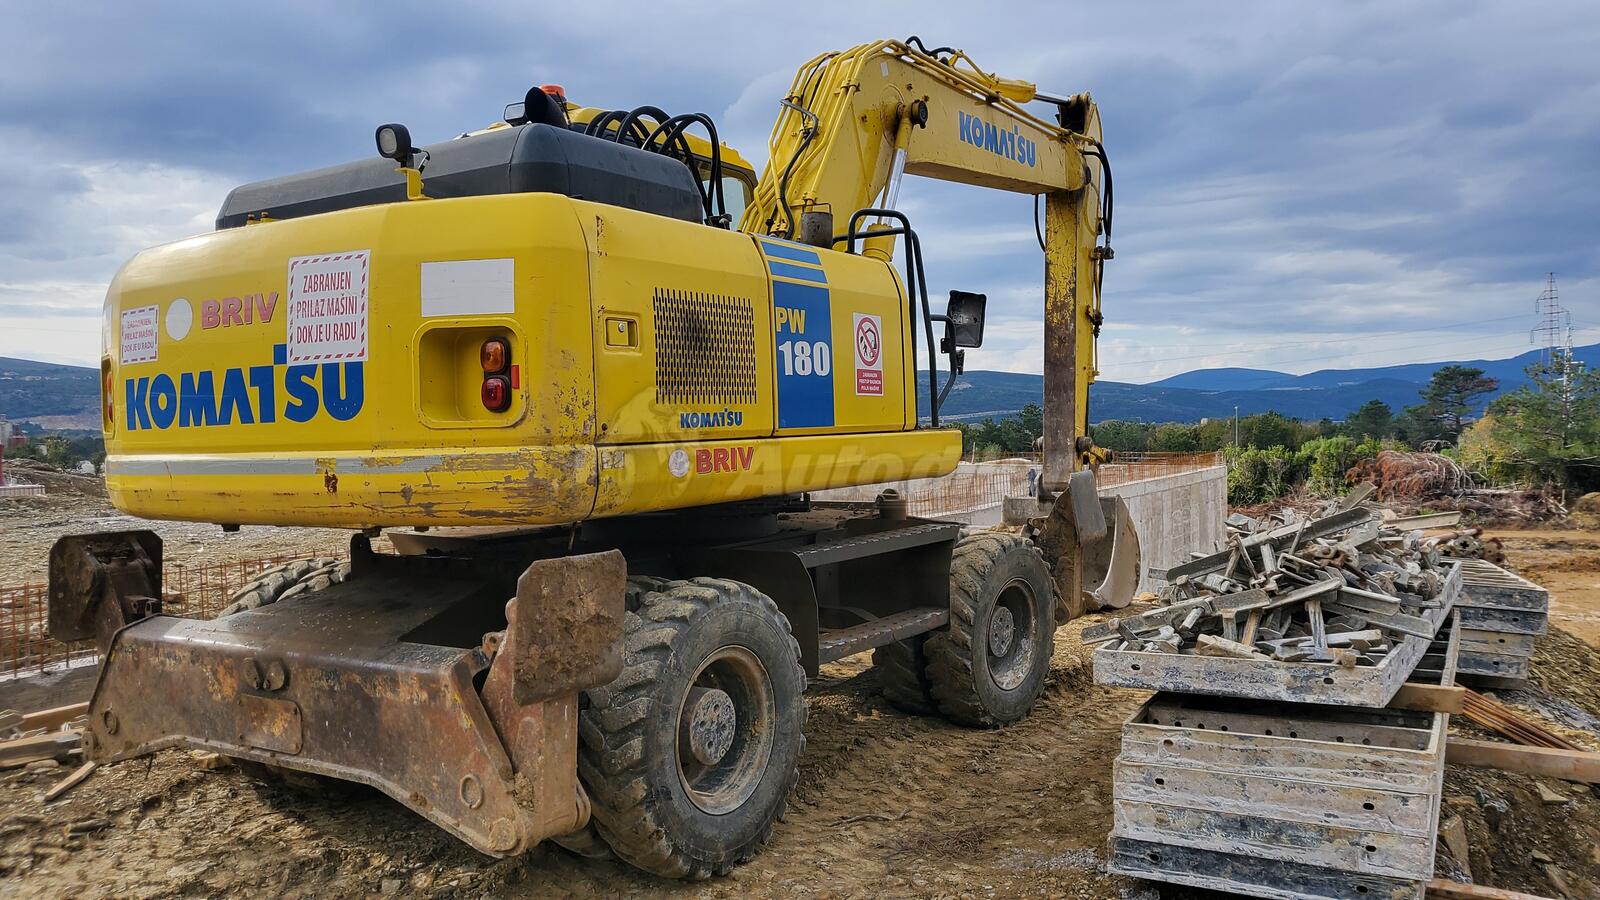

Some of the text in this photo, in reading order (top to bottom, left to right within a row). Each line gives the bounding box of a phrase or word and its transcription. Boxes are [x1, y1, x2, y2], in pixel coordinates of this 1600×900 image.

[958, 111, 1036, 168] KOMATSU
[303, 271, 351, 294] ZABRANJEN
[201, 291, 279, 330] BRIV
[297, 294, 358, 319] PRILAZ MAŠINI
[775, 306, 806, 334] PW
[297, 321, 357, 344] DOK JE U RADU
[778, 340, 830, 376] 180
[124, 343, 365, 431] KOMATSU
[680, 407, 743, 429] KOMATSU
[696, 446, 755, 475] BRIV
